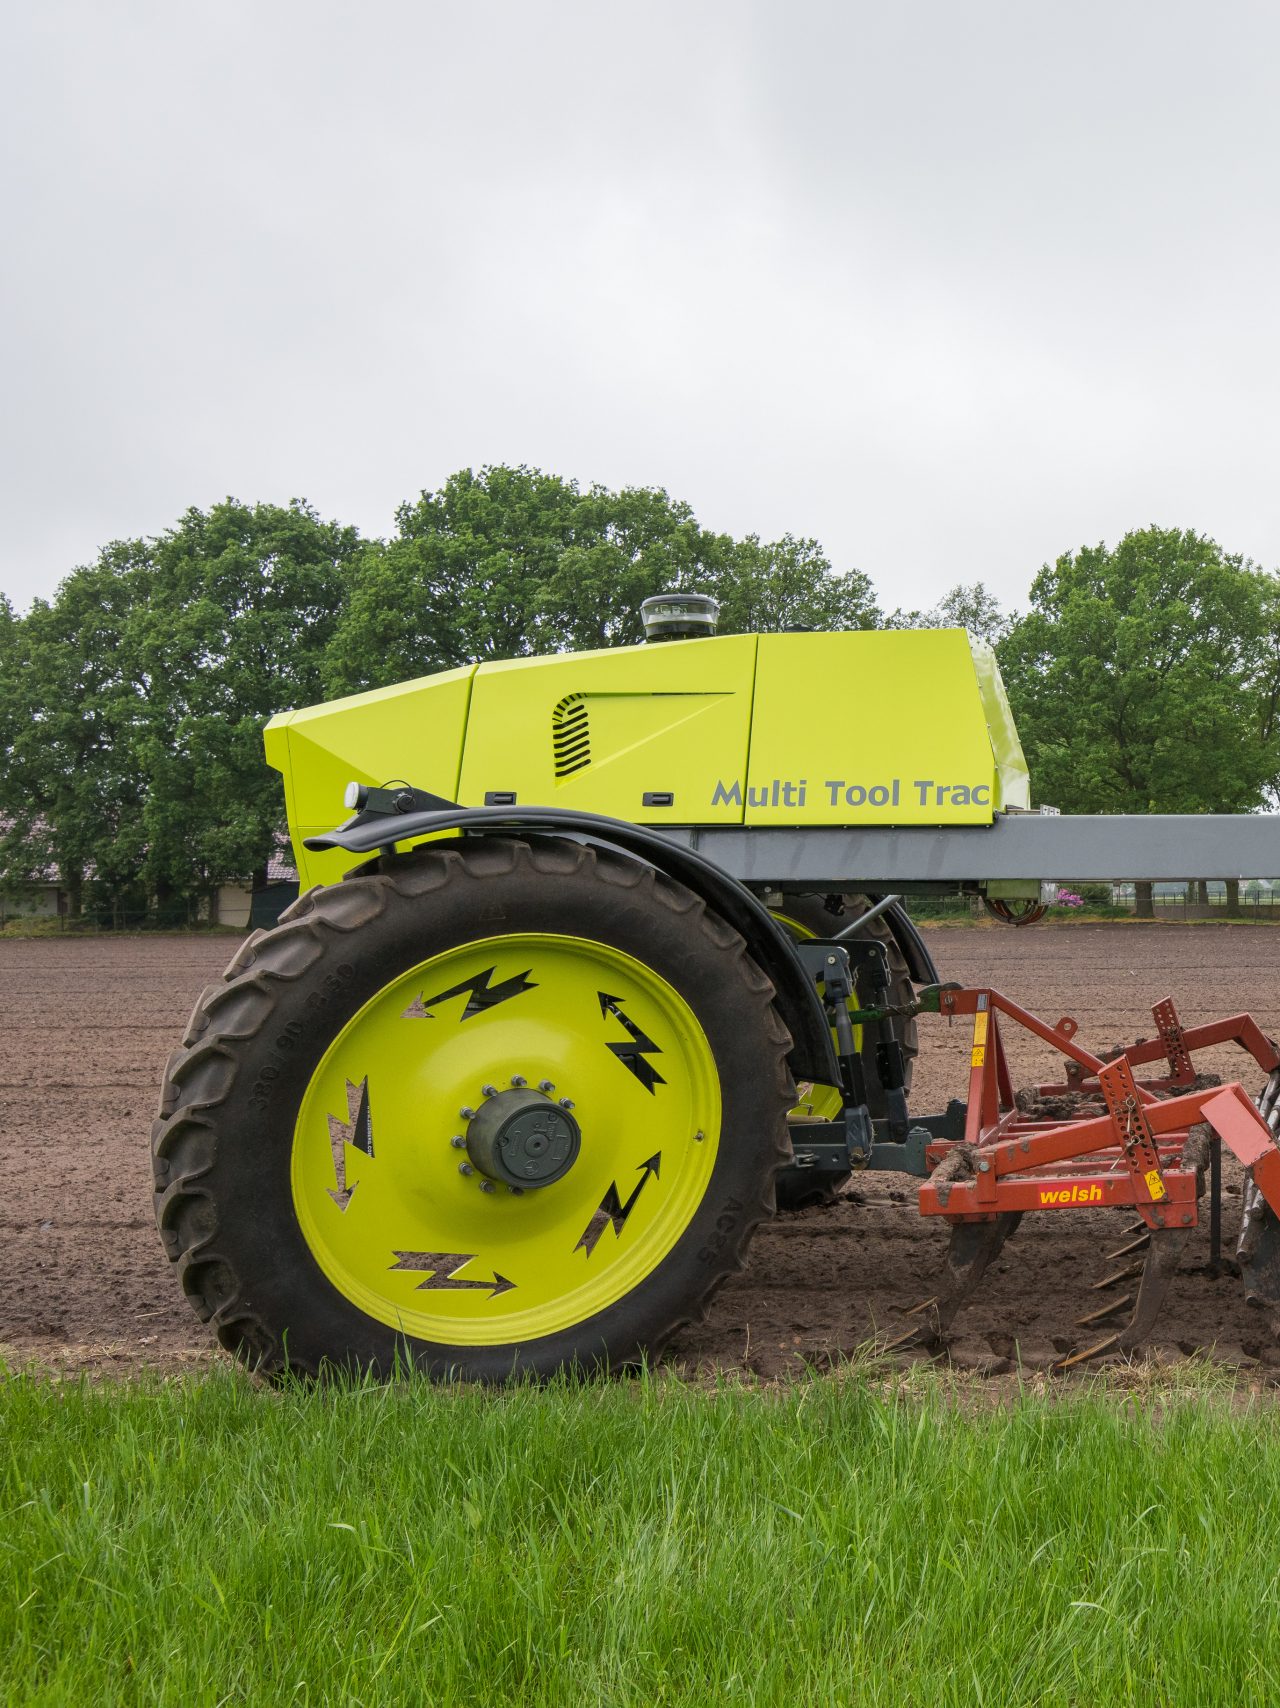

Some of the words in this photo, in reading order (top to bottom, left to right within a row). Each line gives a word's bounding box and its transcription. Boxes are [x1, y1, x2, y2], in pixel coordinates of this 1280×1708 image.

[711, 779, 807, 807] Multi
[825, 779, 900, 806] Tool
[913, 780, 990, 806] Trac
[1040, 1184, 1102, 1204] welsh
